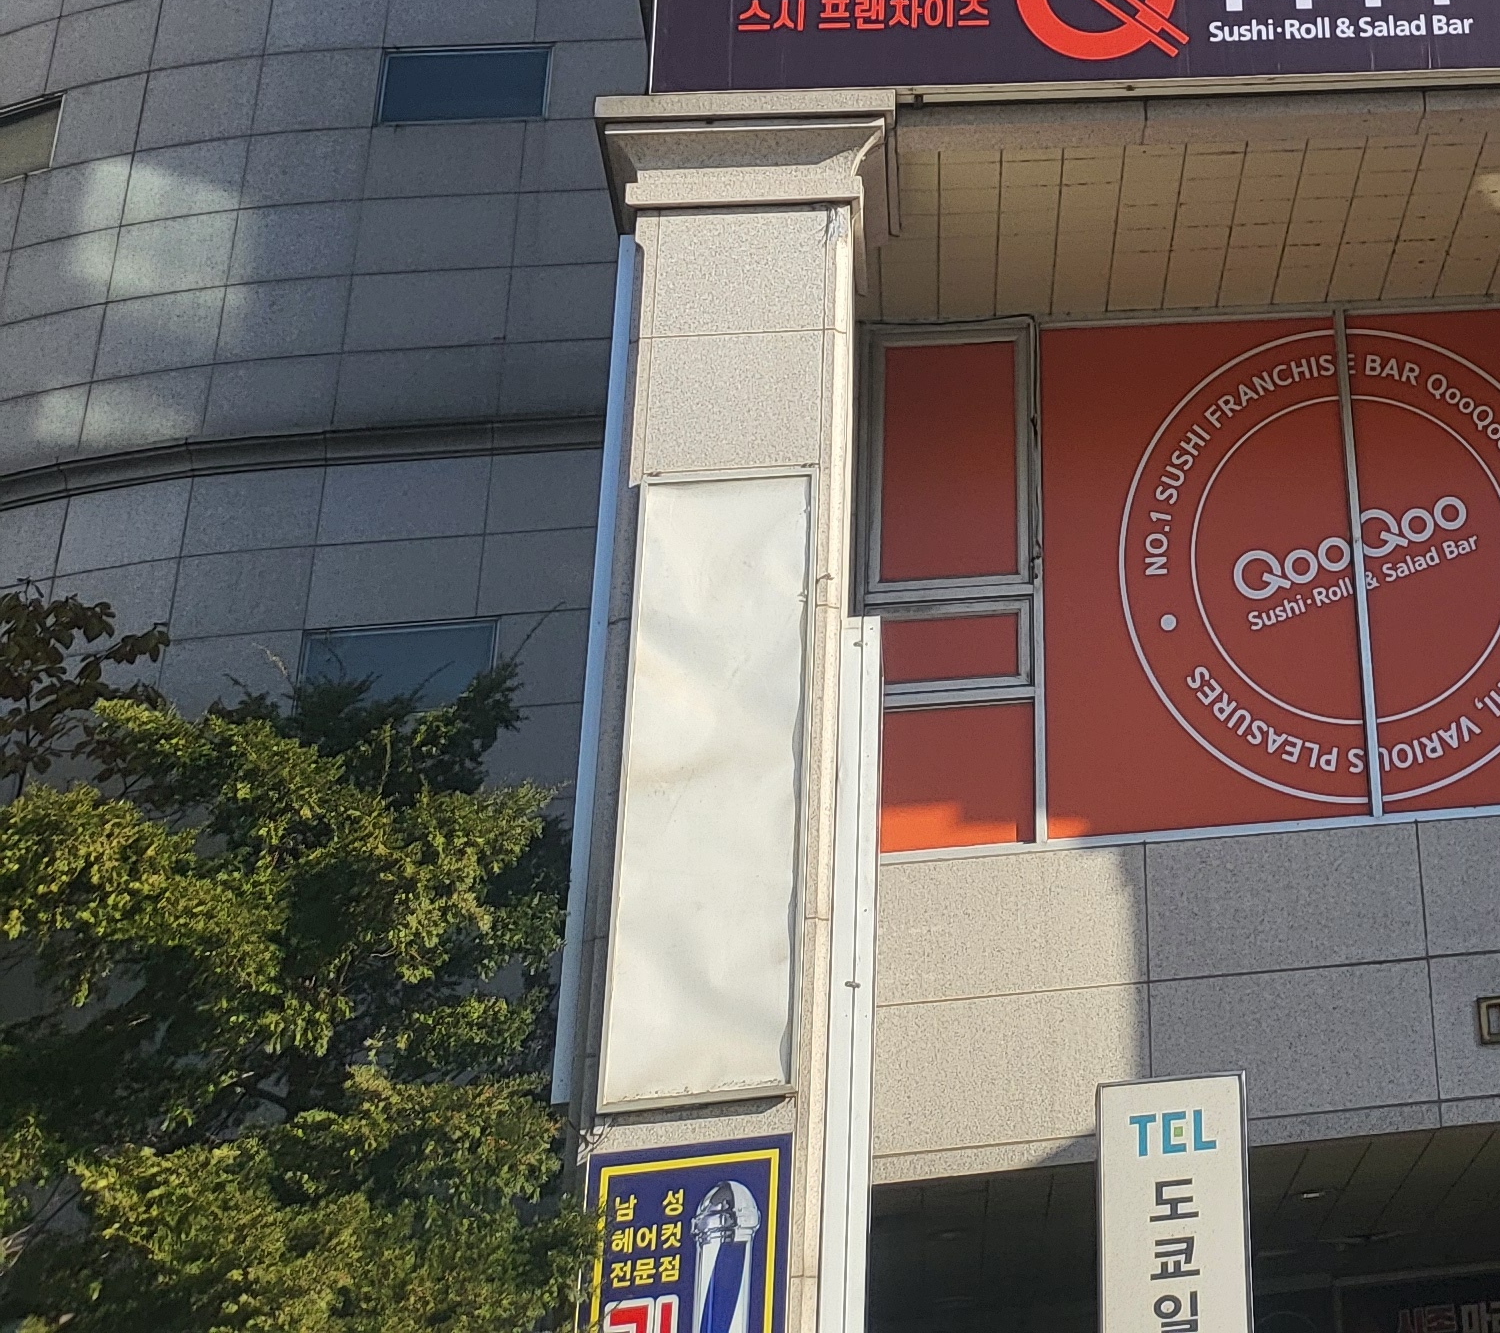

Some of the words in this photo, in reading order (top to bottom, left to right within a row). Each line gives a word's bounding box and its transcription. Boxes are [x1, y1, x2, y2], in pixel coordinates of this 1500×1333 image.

[1334, 18, 1355, 39] &
[1357, 15, 1427, 39] Salad
[1431, 14, 1475, 37] Bar
[1364, 353, 1421, 387] BAR
[1155, 422, 1213, 507] SUSHI
[1144, 509, 1174, 577] NO.1
[1232, 495, 1469, 601] QooQoo
[1380, 547, 1442, 584] Salad
[1444, 533, 1480, 560] Bar
[1186, 665, 1340, 773] PLEASURES
[1128, 1108, 1218, 1158] TEL
[611, 1220, 682, 1255] 헤어컷
[609, 1253, 682, 1289] 전문점
